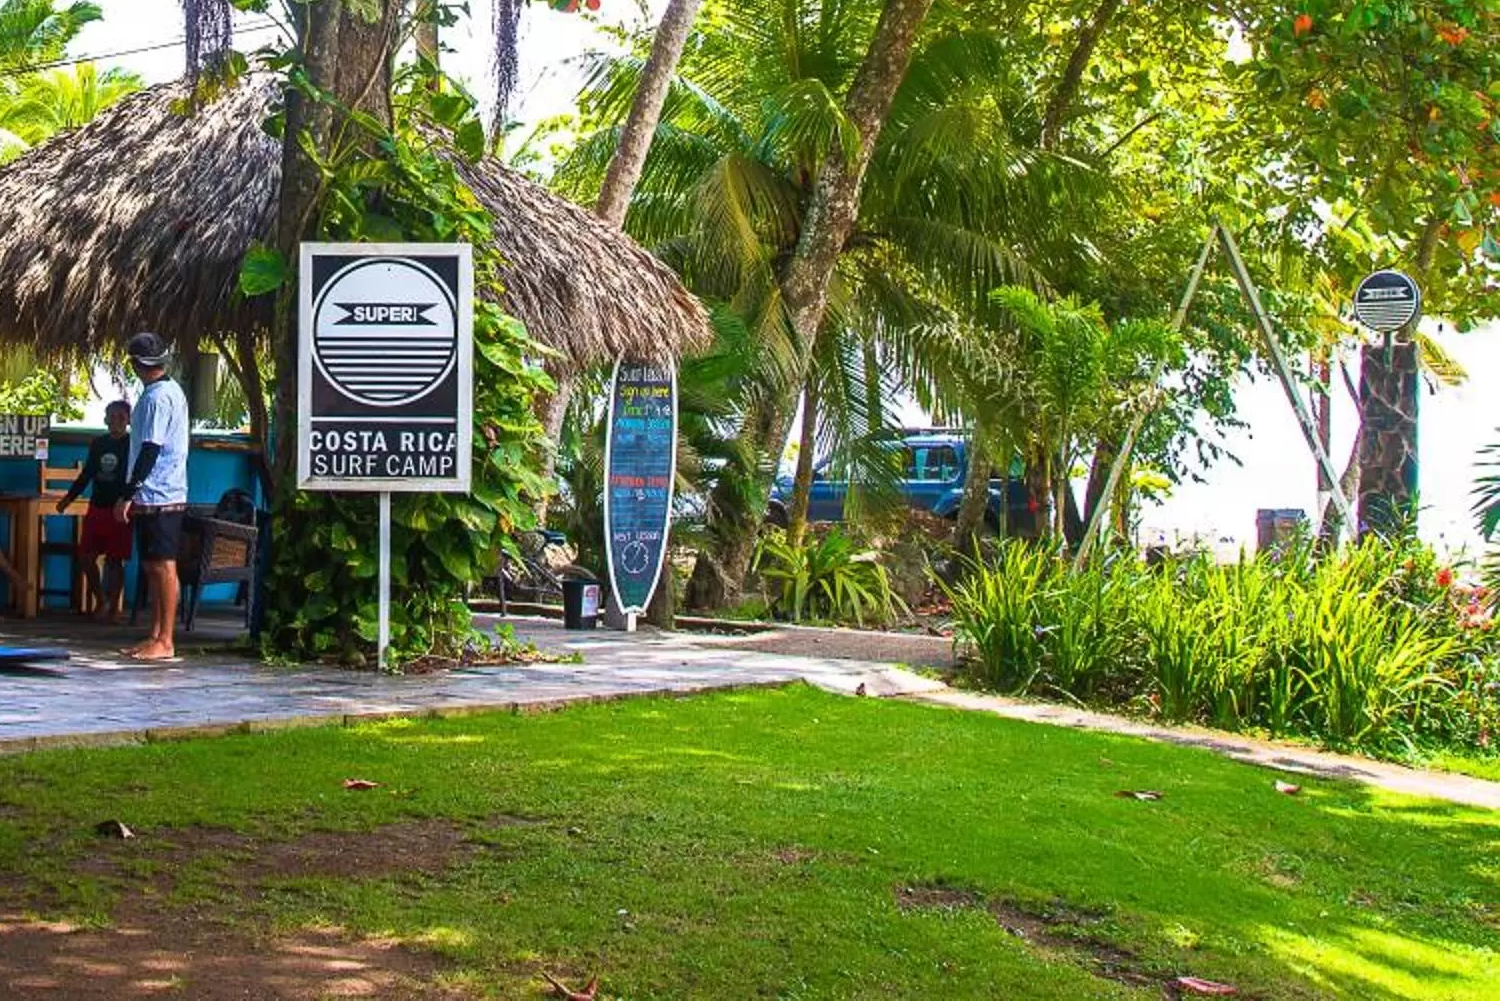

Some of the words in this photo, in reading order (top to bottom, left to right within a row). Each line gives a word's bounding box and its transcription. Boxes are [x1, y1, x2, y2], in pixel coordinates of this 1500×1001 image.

[353, 306, 418, 323] SUPER!
[24, 415, 49, 435] UP
[310, 430, 387, 452] COSTA
[400, 431, 458, 451] RICA
[313, 454, 378, 476] SURF
[386, 455, 453, 476] CAMP
